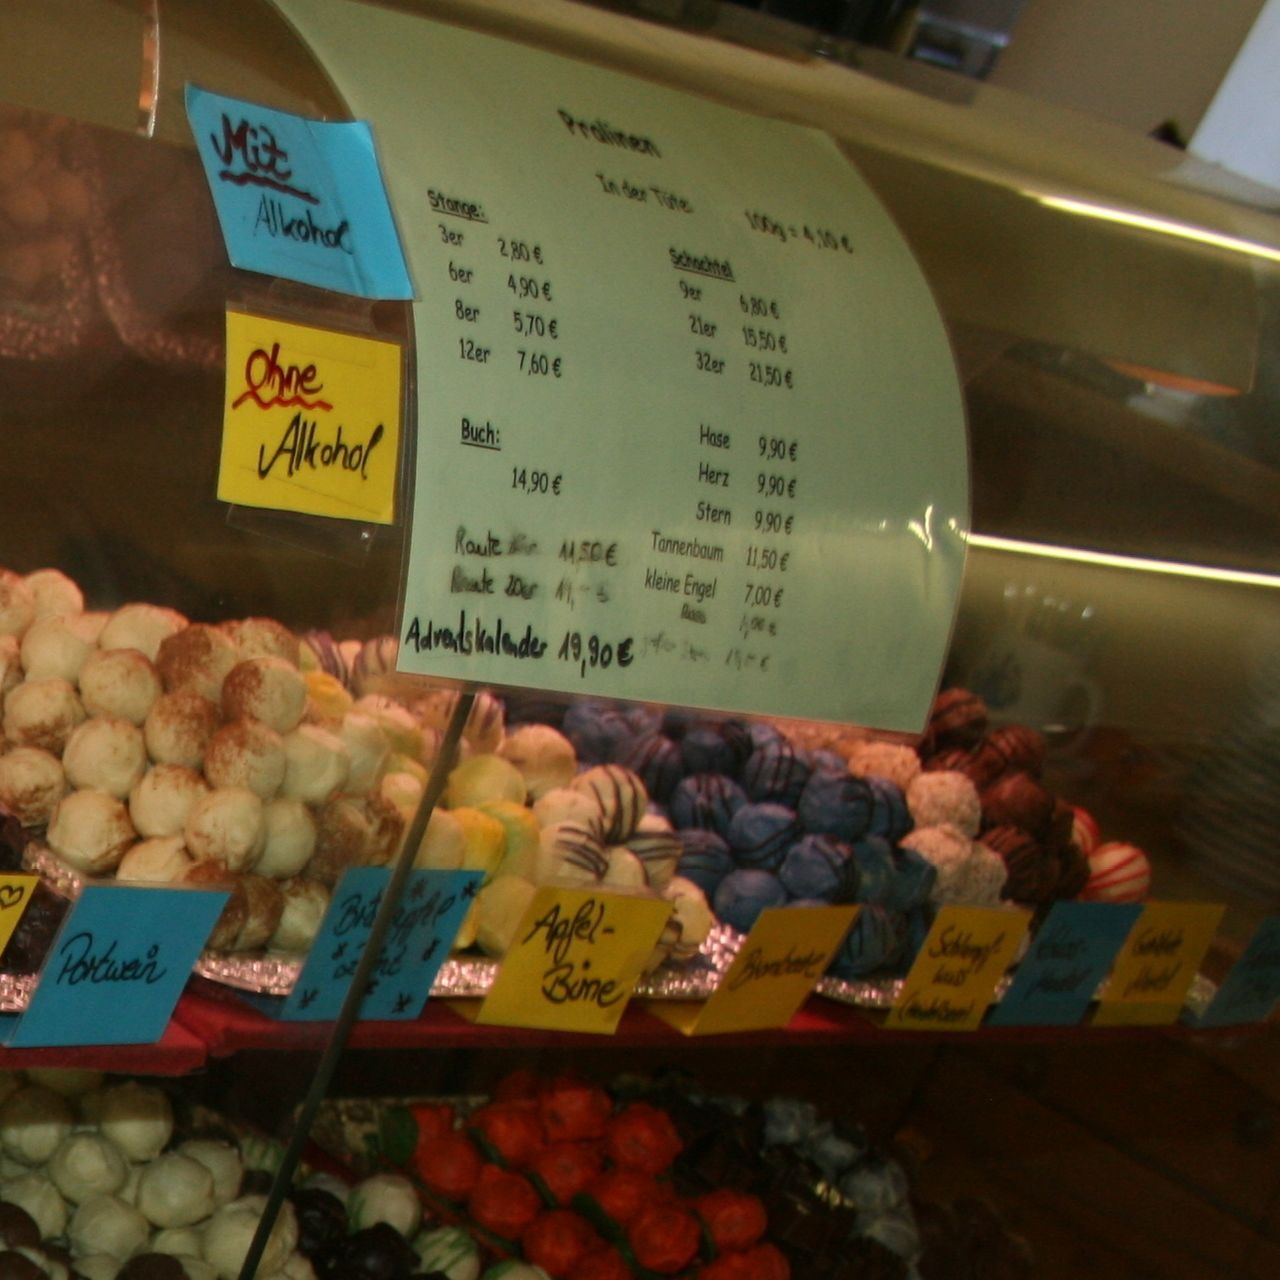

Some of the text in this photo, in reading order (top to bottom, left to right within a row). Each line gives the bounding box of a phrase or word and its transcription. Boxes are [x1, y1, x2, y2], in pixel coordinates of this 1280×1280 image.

[210, 113, 292, 180] Mit
[557, 108, 663, 160] Pralinen
[252, 194, 356, 256] Alkohol
[427, 189, 486, 220] Stange:
[438, 223, 544, 266] 3er 2,80 €
[448, 261, 553, 302] 6er 4,90 €
[679, 279, 703, 302] 9er
[455, 299, 559, 340] 8er 5,70 €
[246, 343, 324, 396] Ohne
[459, 337, 563, 379] 12er 7,60 €
[696, 350, 726, 376] 32er
[259, 412, 386, 481] Alkohol
[460, 417, 501, 446] Buch:
[700, 423, 798, 462] Hase 9,90 €
[512, 466, 563, 496] 14,90 €
[698, 461, 797, 500] Herz 9,90 €
[695, 500, 794, 536] Stern 9,90 €
[651, 530, 790, 573] Tannenbaum 11,50 €
[644, 567, 784, 609] kleine Engel 7,00 €
[557, 631, 614, 679] 19,90
